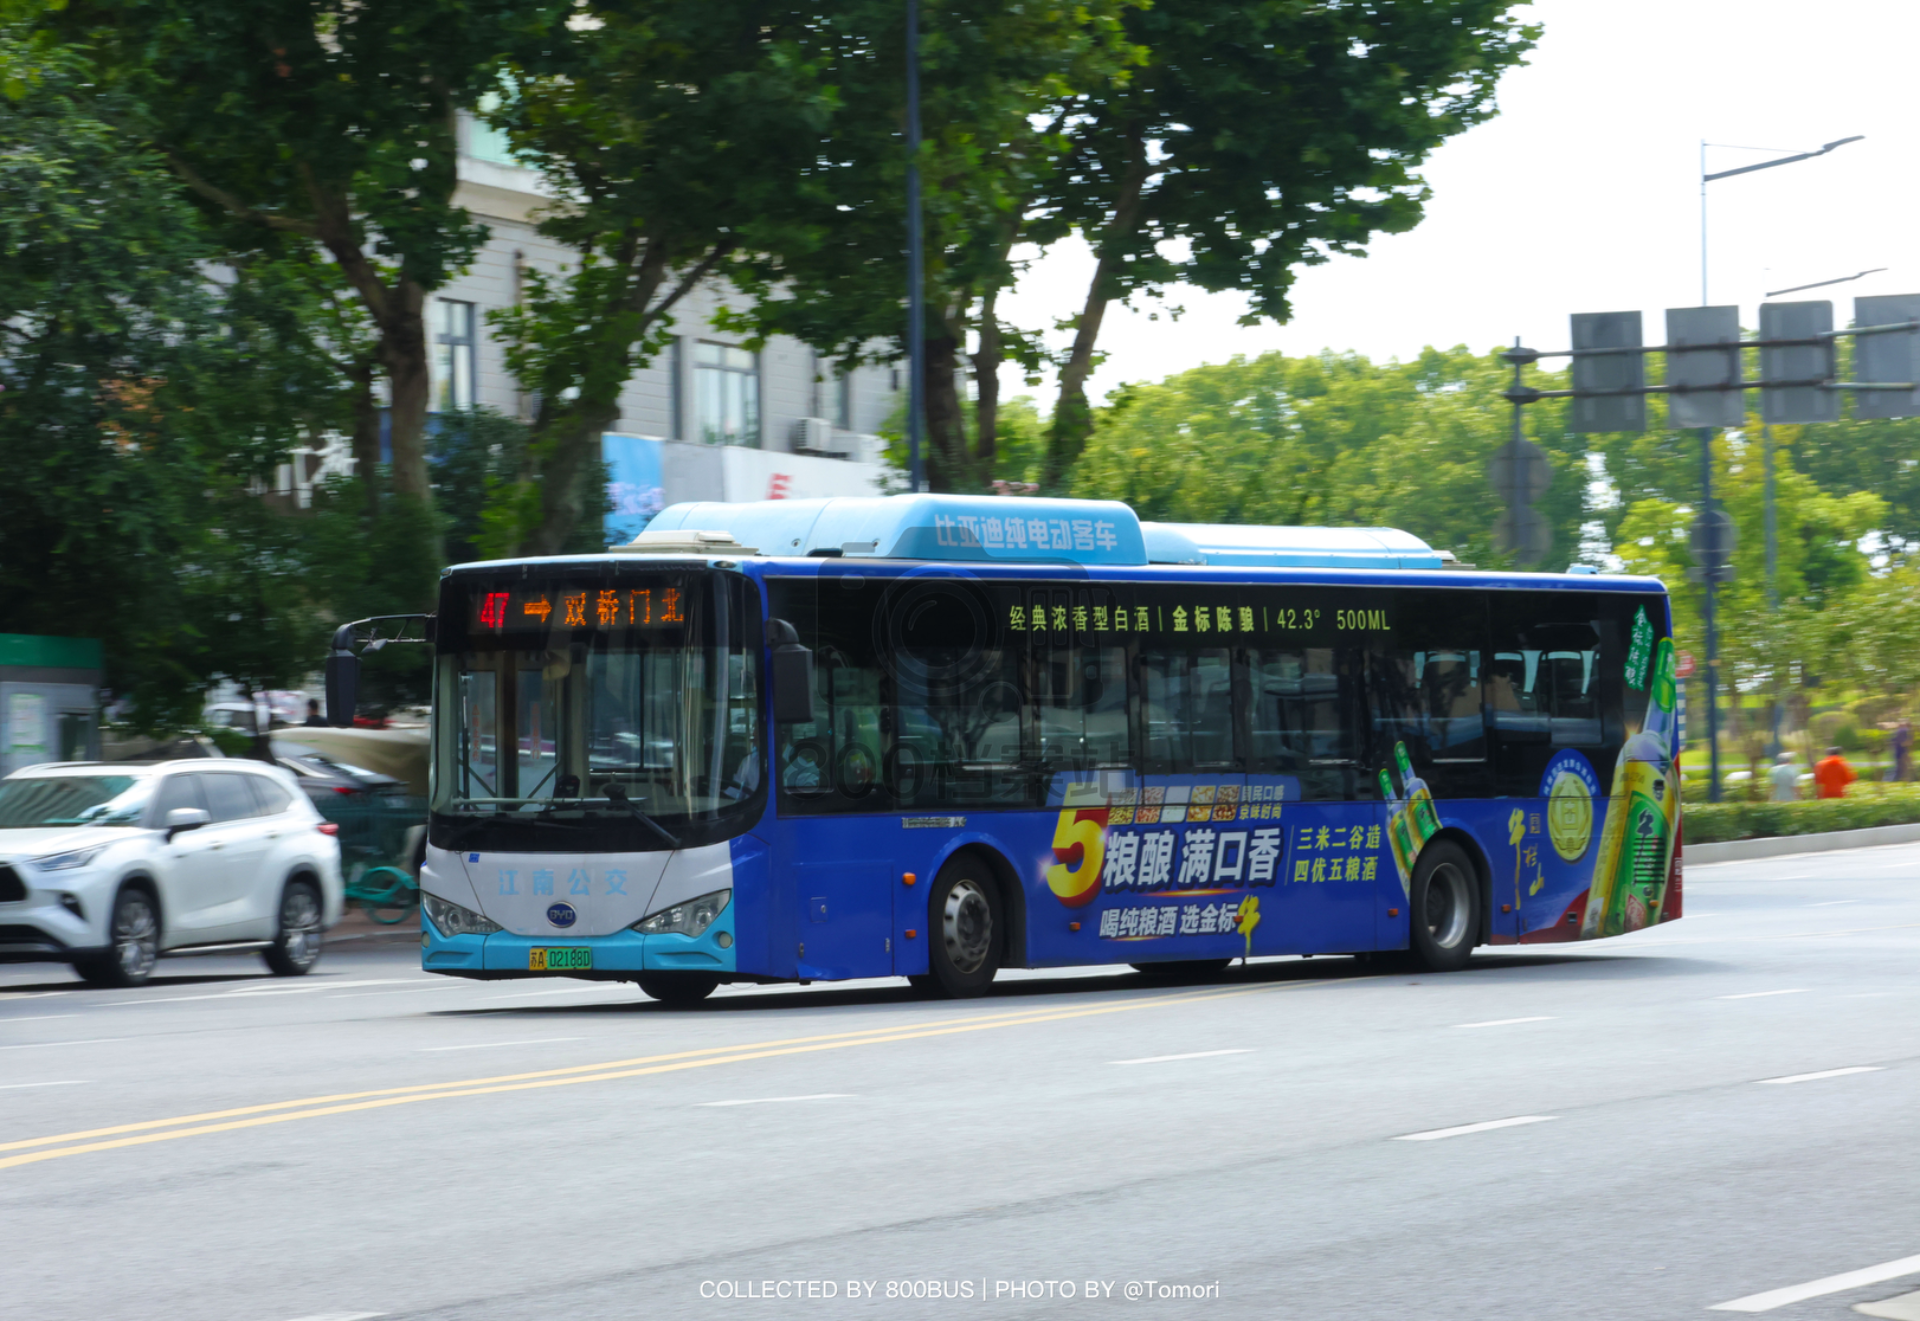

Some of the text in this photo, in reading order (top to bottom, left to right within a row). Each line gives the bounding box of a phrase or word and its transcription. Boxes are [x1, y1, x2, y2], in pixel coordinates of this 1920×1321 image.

[934, 513, 1118, 552] 比亚迪纯电动客车
[479, 592, 510, 628] 47
[563, 588, 684, 627] 双桥门北
[1009, 604, 1150, 632] 经典浓香型白酒
[1336, 610, 1391, 630] 500ML
[1046, 782, 1113, 907] 5
[1296, 824, 1381, 850] 三米二谷造
[1103, 827, 1281, 887] 粮酿满口香
[1293, 856, 1378, 883] 四优五粮酒
[498, 868, 628, 896] 江南公交
